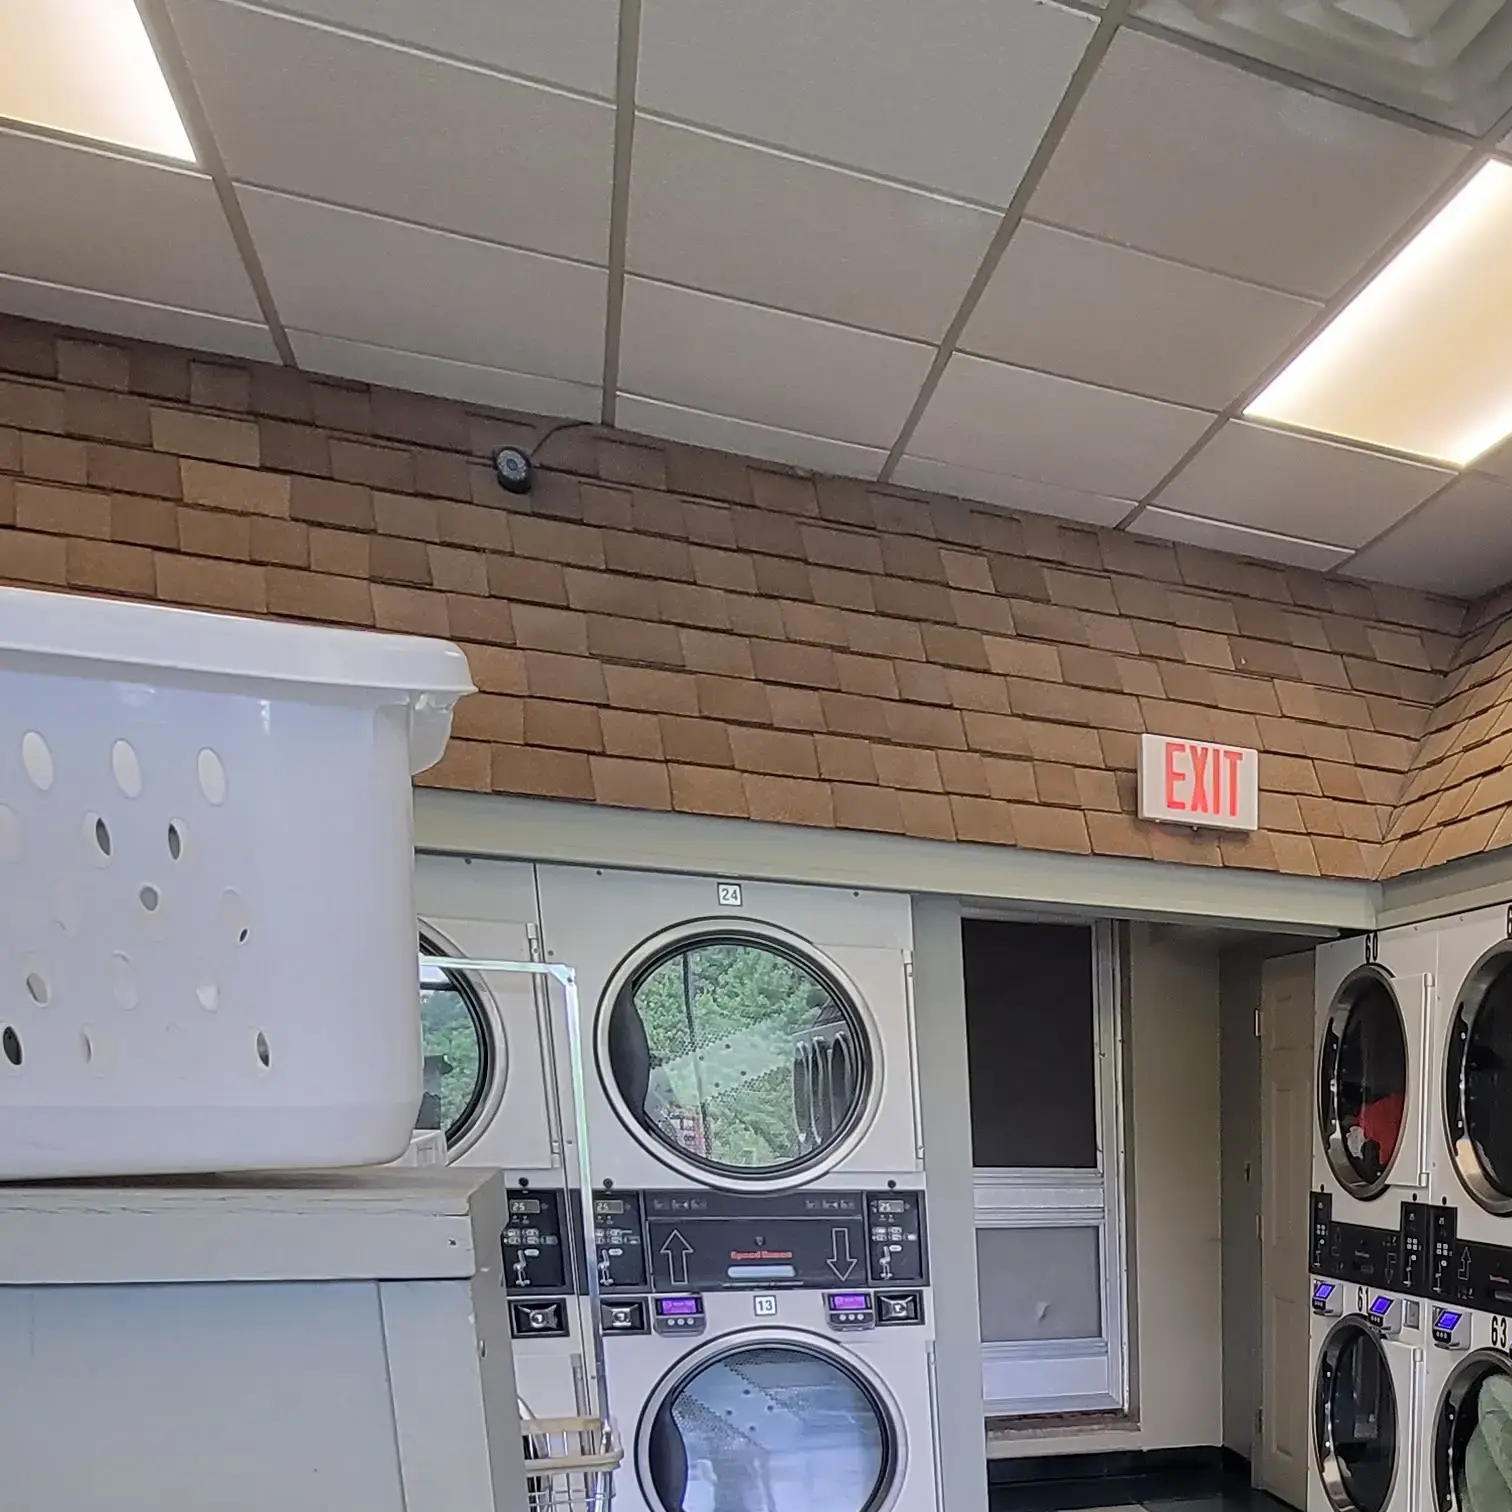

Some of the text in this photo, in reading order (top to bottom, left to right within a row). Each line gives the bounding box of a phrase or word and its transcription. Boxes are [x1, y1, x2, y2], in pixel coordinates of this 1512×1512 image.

[1165, 742, 1243, 817] EXIT
[722, 888, 738, 901] 24
[1365, 931, 1379, 963] 60
[757, 1300, 773, 1311] 13
[1357, 1286, 1369, 1312] 61
[1491, 1315, 1507, 1348] 63
